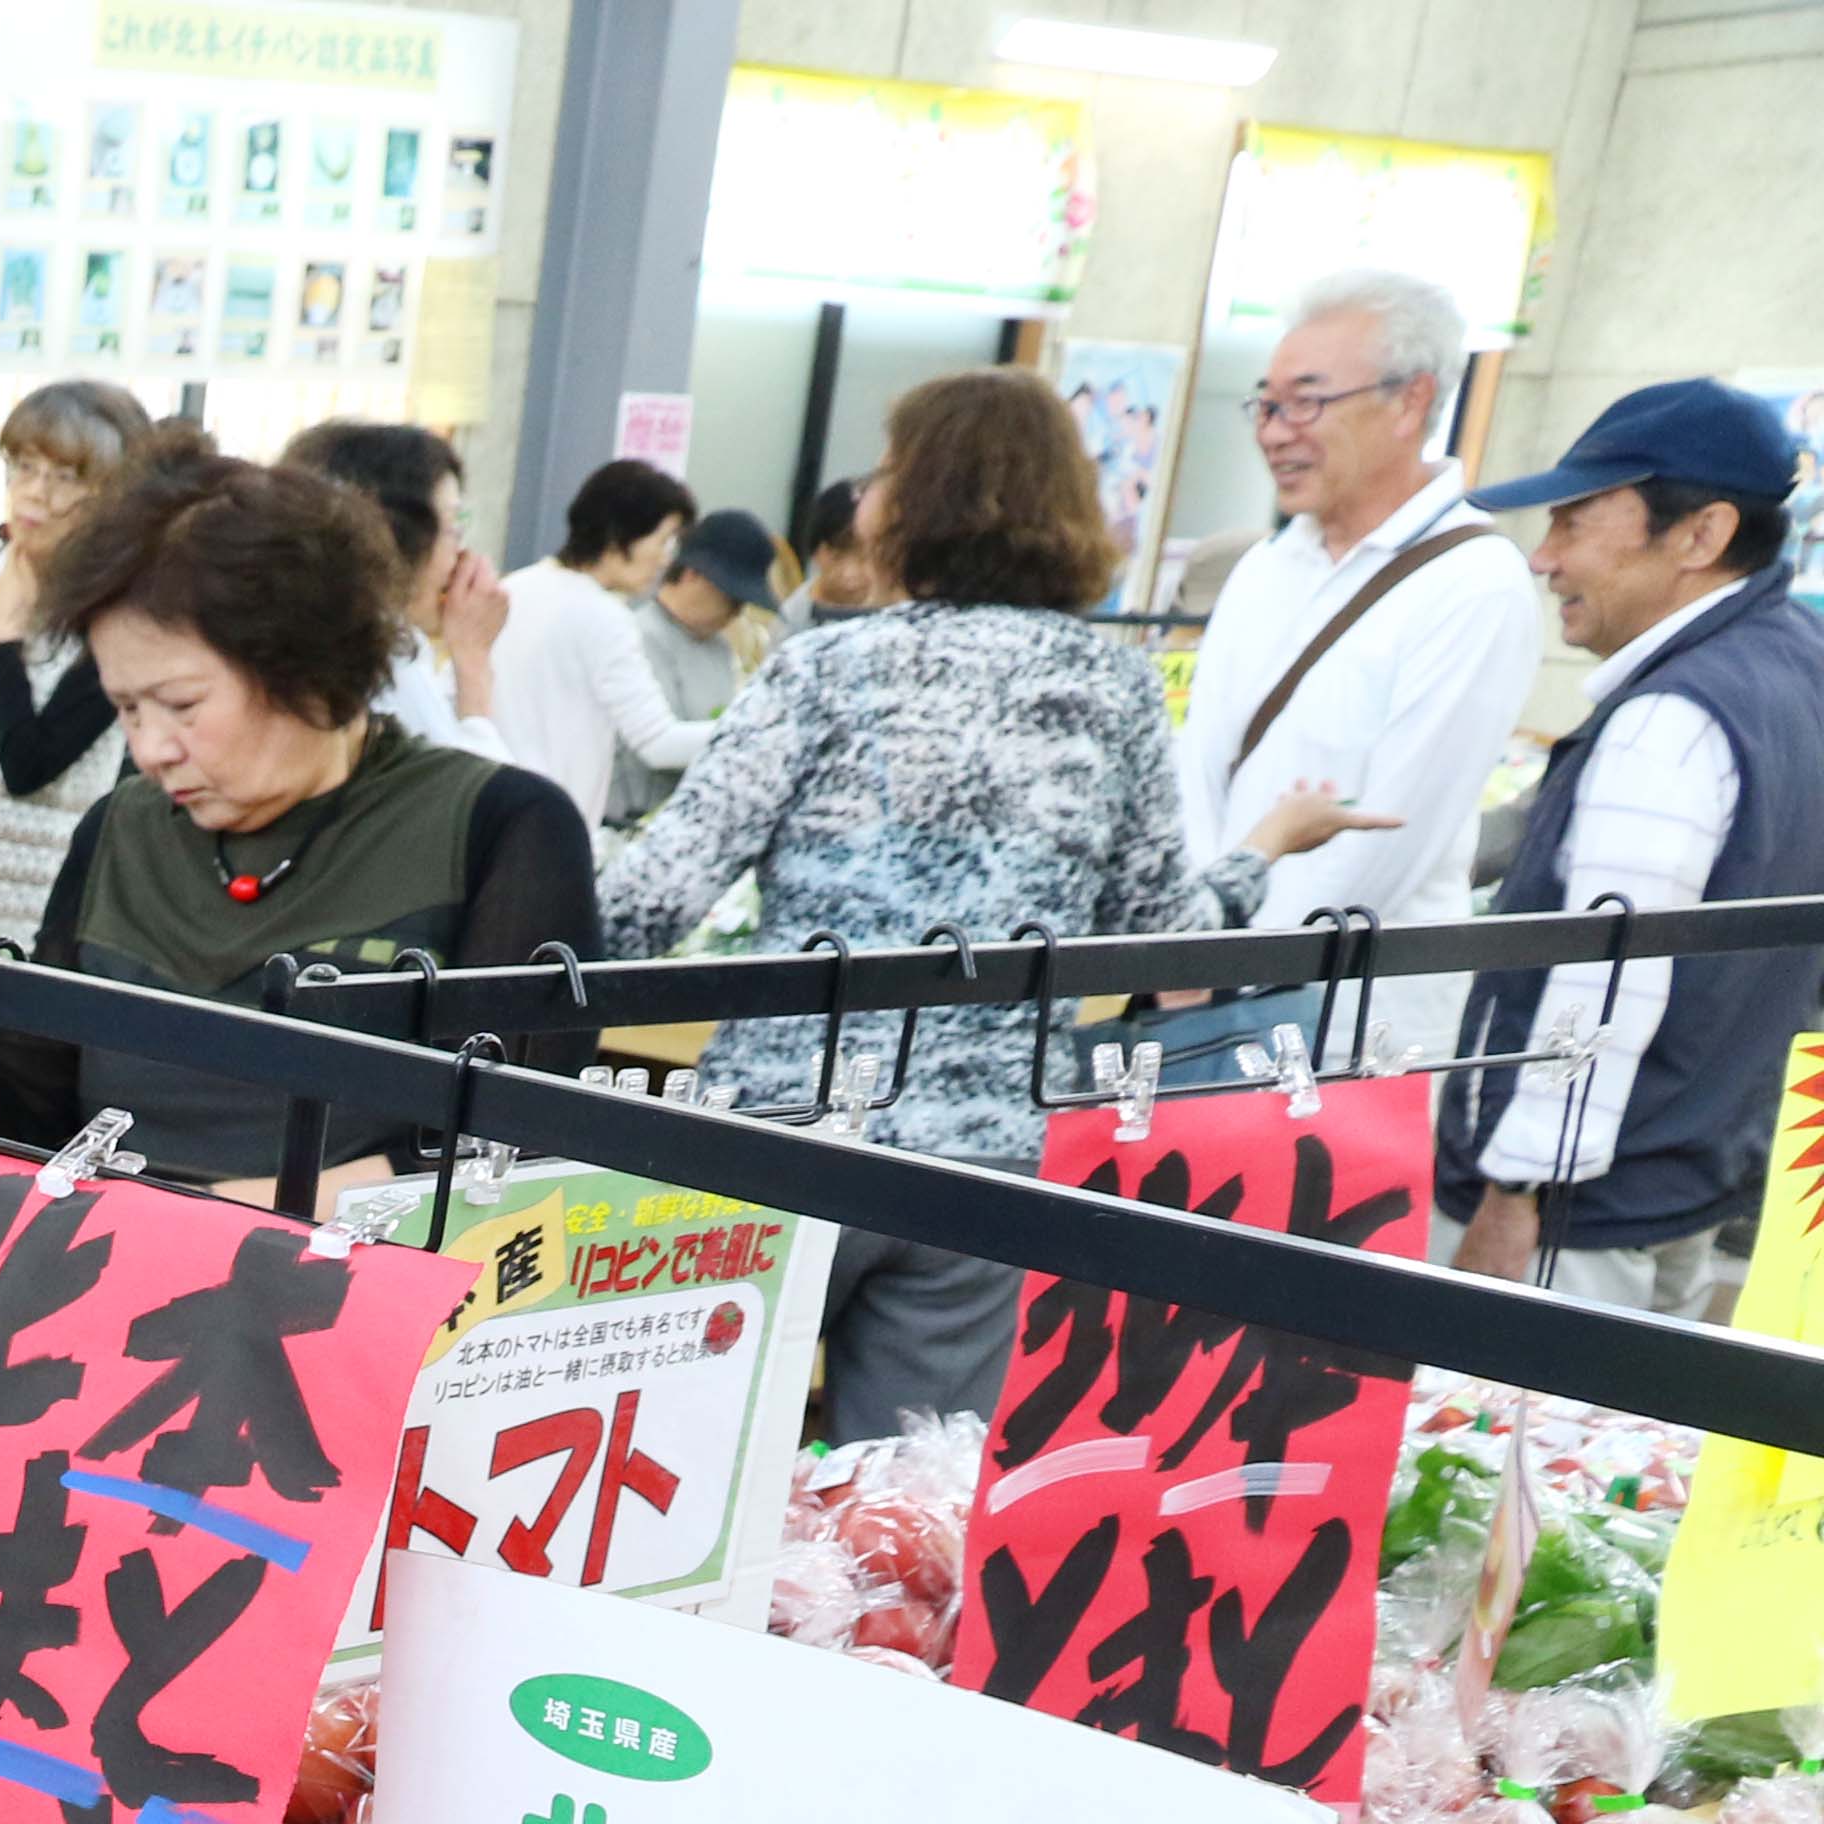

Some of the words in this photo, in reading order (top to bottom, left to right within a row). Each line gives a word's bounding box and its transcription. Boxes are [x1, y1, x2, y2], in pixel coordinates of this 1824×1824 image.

[570, 1222, 784, 1300] リコピンで美肌に
[456, 1307, 708, 1367] 北本のトマトは全国でも有名です
[369, 1388, 682, 1633] トマト
[542, 1696, 679, 1762] 埼玉県産
